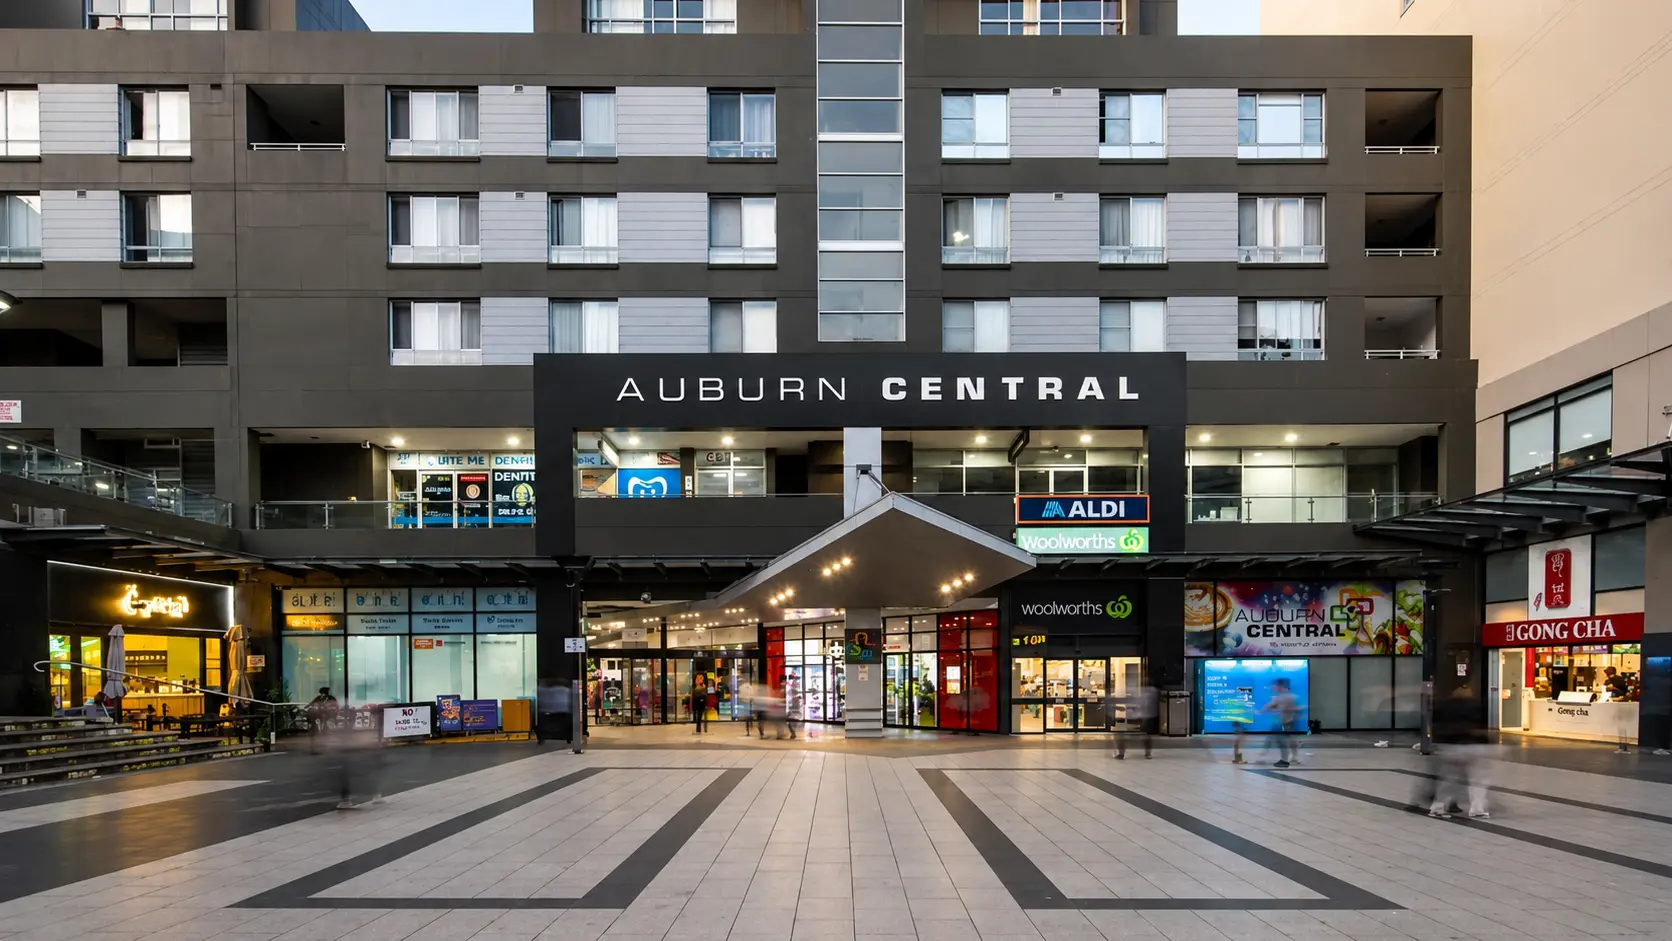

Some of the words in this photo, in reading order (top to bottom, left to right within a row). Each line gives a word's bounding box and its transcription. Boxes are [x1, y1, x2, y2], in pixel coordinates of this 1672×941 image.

[616, 377, 846, 402] AUBURN
[881, 376, 1139, 401] CENTRAL
[1068, 500, 1125, 518] ALDI
[1246, 624, 1346, 638] CENTRAL
[1516, 621, 1569, 641] GONG
[1573, 619, 1616, 639] CHA
[1557, 706, 1575, 717] Gong
[1576, 707, 1589, 716] cha
